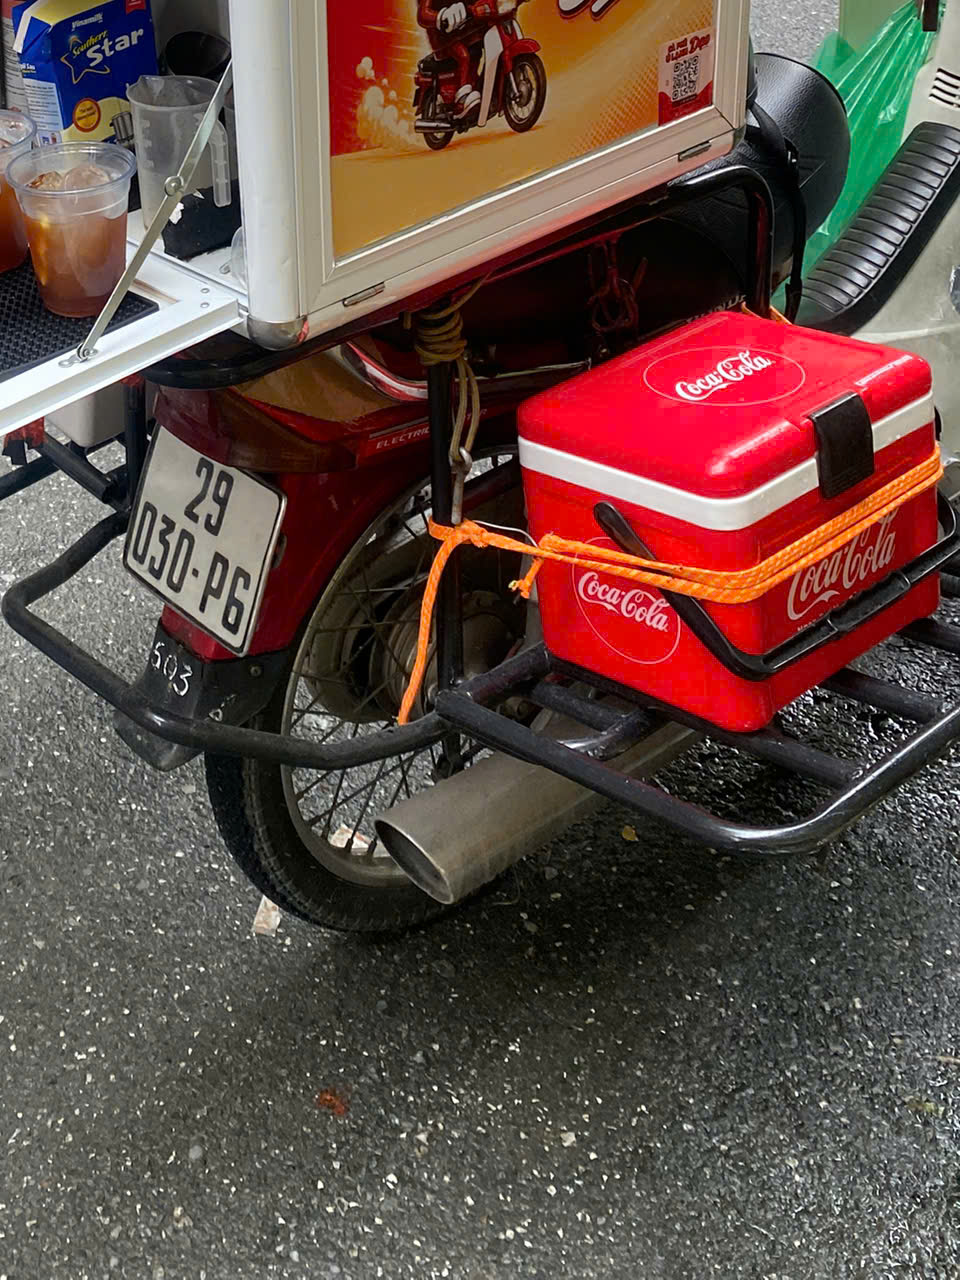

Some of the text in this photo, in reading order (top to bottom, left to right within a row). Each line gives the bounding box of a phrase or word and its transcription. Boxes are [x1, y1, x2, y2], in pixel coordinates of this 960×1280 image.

[86, 28, 144, 67] Star
[675, 348, 772, 402] Coca-Cola
[184, 457, 235, 537] 29
[132, 501, 251, 636] 030-P6
[578, 570, 669, 634] Coca-Cola
